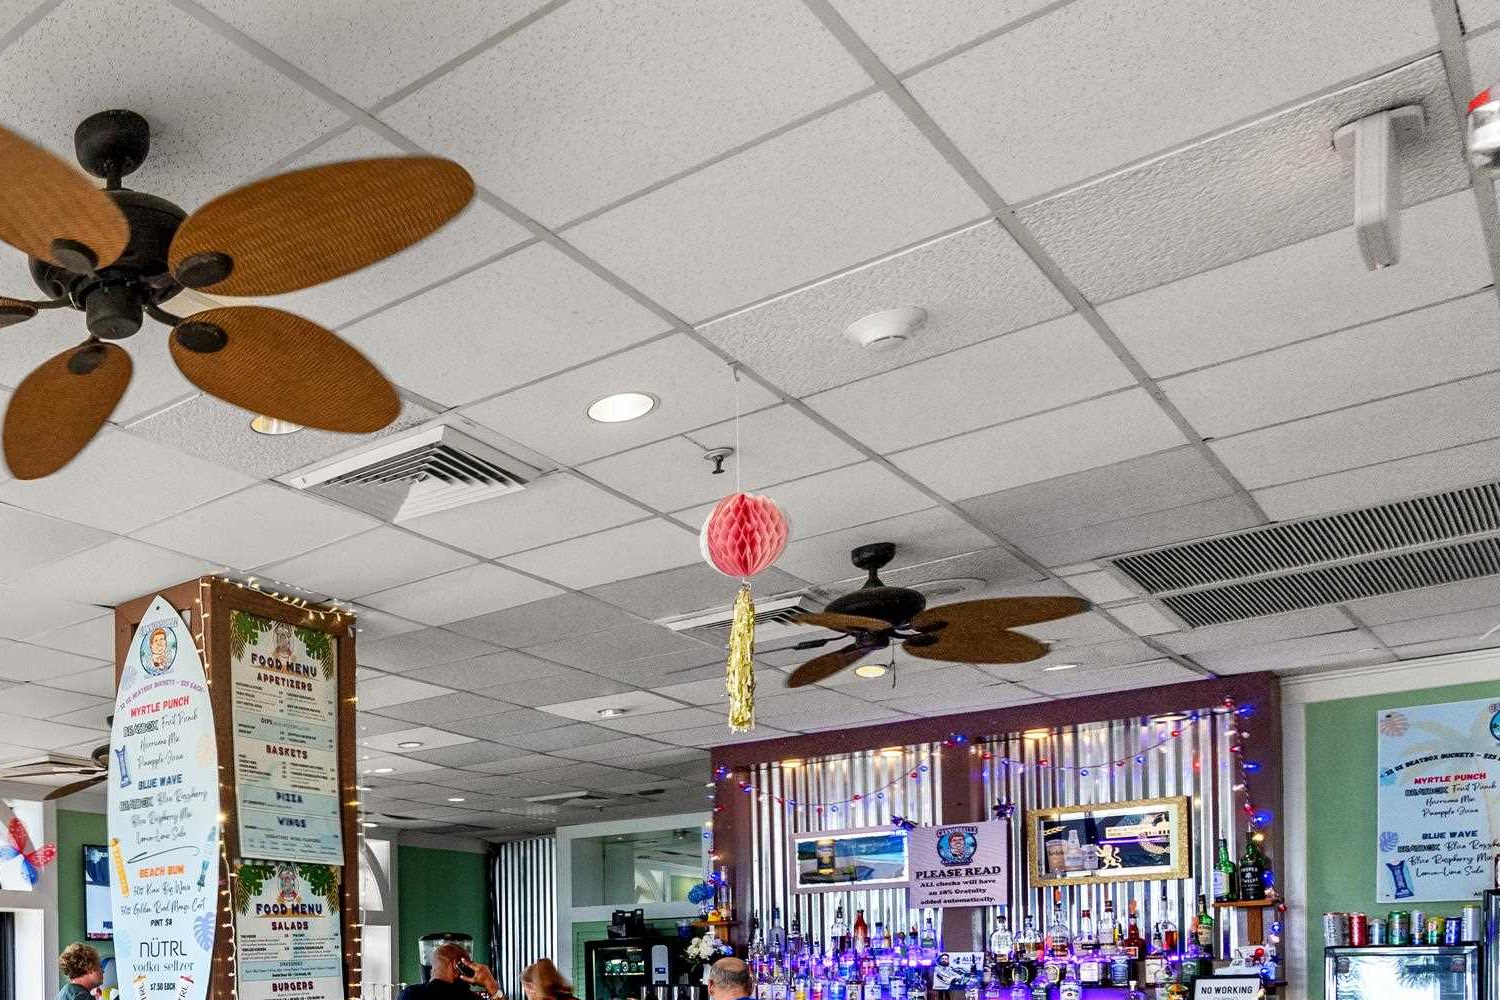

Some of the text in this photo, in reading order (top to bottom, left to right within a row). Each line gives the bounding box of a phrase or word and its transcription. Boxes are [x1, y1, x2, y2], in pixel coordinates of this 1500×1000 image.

[251, 653, 317, 677] FOOD MENU
[257, 673, 313, 691] APPETIZERS
[130, 696, 189, 718] MYRTLE PUNCH
[177, 708, 197, 725] Punch
[266, 744, 308, 760] BASKETS
[1405, 755, 1438, 767] BEATBOX
[138, 774, 183, 790] BLUE WAVE
[1414, 773, 1486, 784] MYRTLE PUNCH
[1452, 783, 1470, 793] Fruit
[1472, 780, 1497, 792] Punch
[276, 792, 303, 803] PIZZA
[1422, 808, 1455, 818] Pineapple
[277, 816, 307, 828] WINGS
[1422, 830, 1478, 840] BLUE WAVE
[1444, 842, 1466, 851] Blue
[1408, 855, 1429, 866] Blue
[140, 864, 185, 878] BEACH BUM
[916, 866, 1001, 879] PLEASE READ
[1464, 866, 1485, 876] Soda
[943, 896, 996, 904] automatically.
[256, 903, 322, 915] FOOD MENU
[150, 919, 163, 927] PINT
[271, 921, 309, 931] SALADS
[133, 960, 195, 972] vodka seltzer
[272, 981, 314, 992] BURGERS
[1201, 986, 1253, 994] NO WORKING
